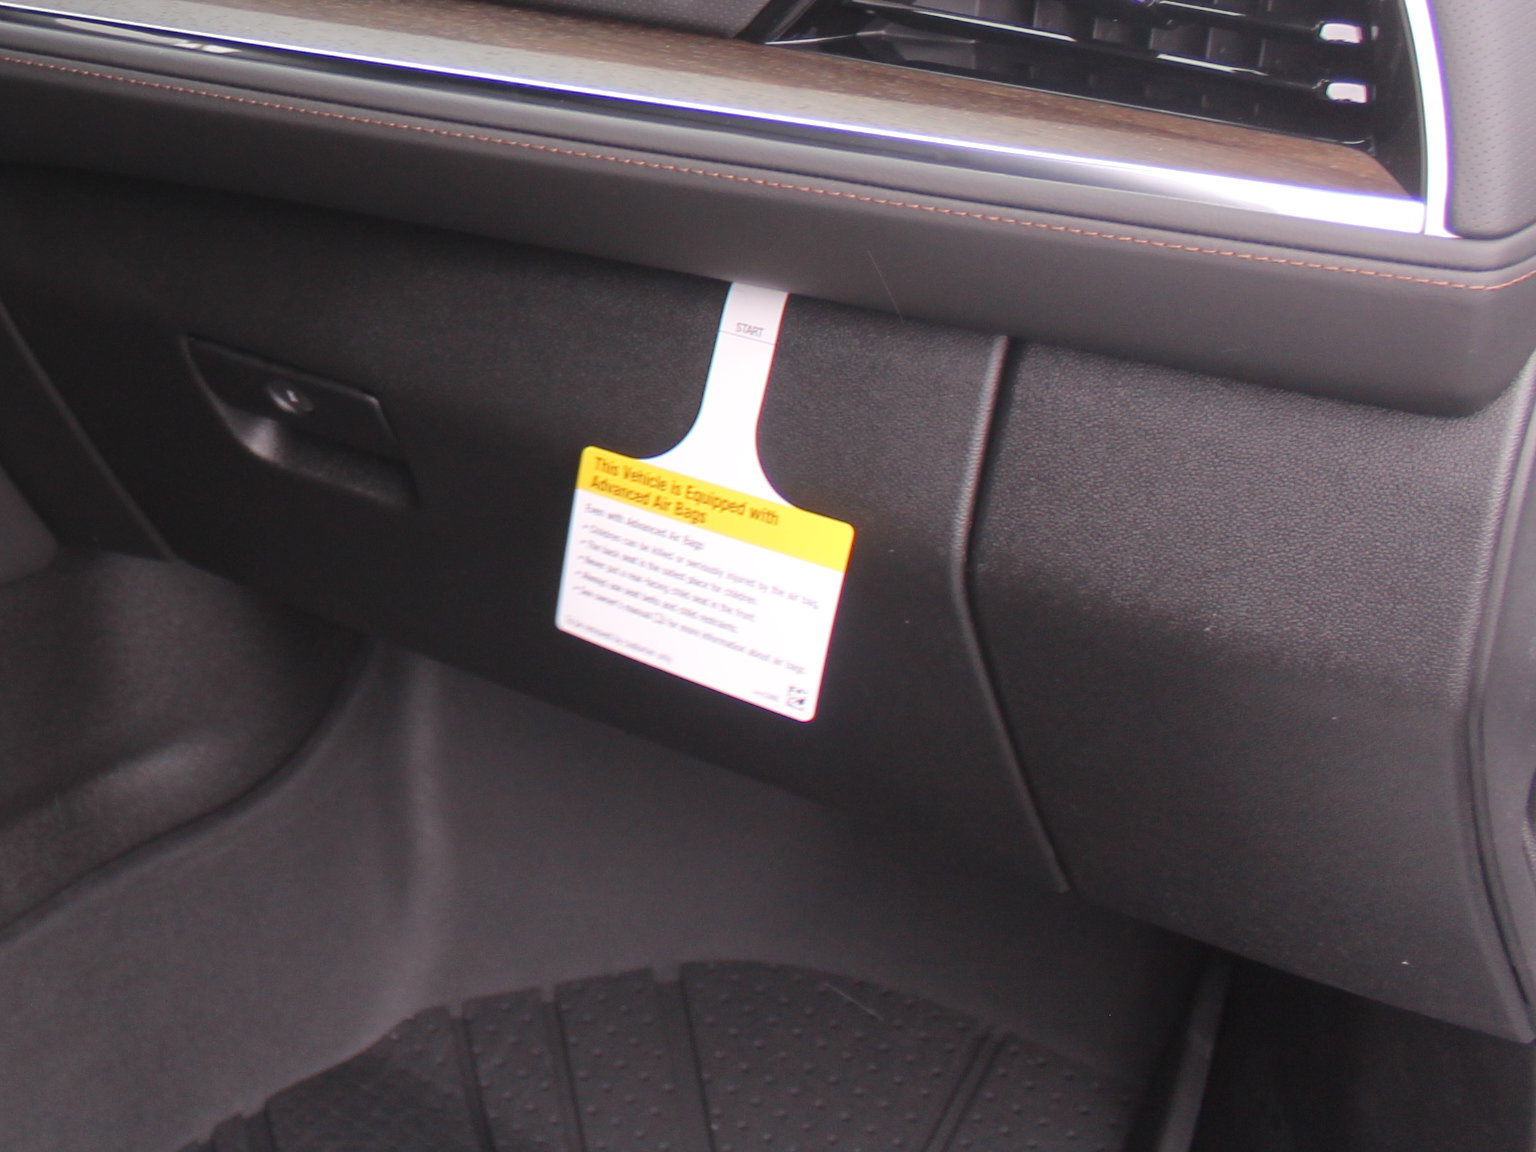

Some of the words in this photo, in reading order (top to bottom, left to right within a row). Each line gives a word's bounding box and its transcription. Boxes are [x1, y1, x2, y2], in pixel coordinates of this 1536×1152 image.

[736, 322, 764, 337] START
[591, 475, 650, 505] Advanced
[653, 495, 672, 512] Air
[674, 502, 708, 525] Bags
[594, 456, 618, 477] This
[623, 465, 667, 491] Vehicle
[670, 481, 682, 497] is
[684, 485, 746, 515] Equipped
[749, 506, 779, 526] with
